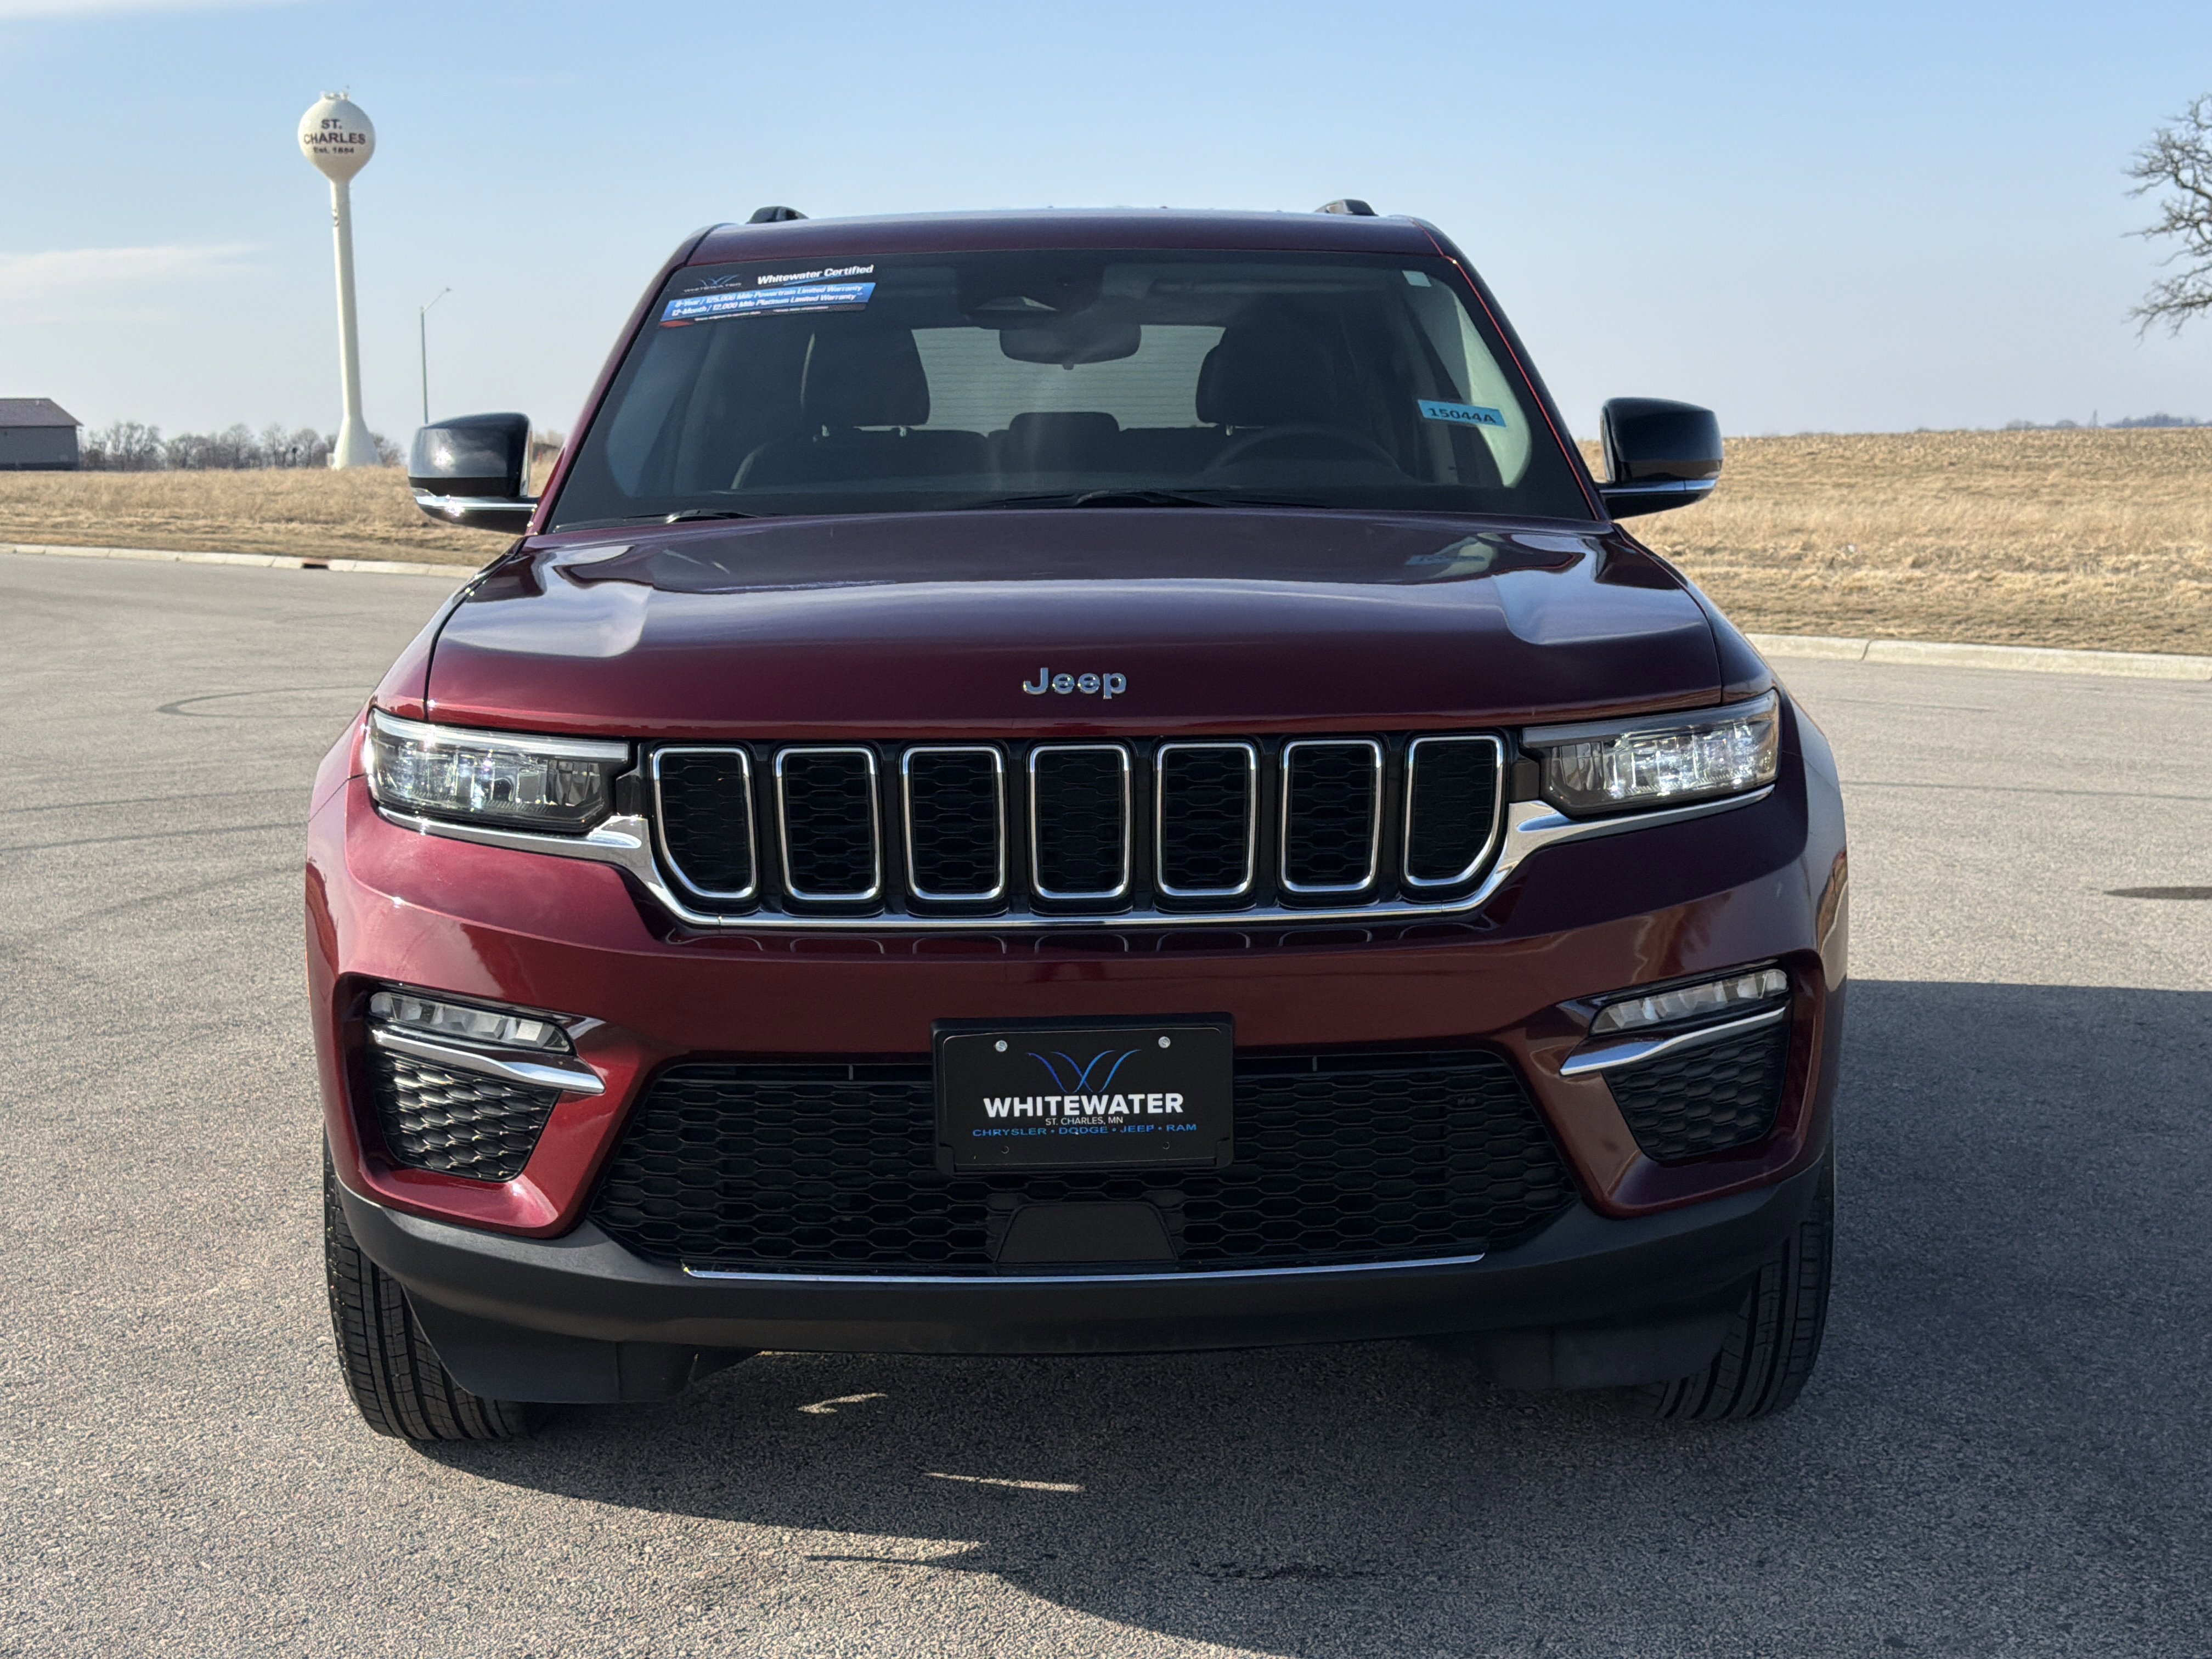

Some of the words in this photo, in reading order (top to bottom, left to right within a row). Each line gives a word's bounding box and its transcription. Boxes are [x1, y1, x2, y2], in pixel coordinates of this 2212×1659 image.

[321, 119, 342, 129] ST.
[303, 132, 366, 145] CHARLES
[757, 270, 822, 285] Whitewater
[823, 264, 874, 276] Certified
[754, 289, 795, 298] Powertrain
[797, 285, 826, 294] Limited
[827, 285, 863, 293] Warranty
[755, 297, 789, 306] Platinum
[790, 295, 819, 303] Limited
[1428, 408, 1496, 423] 15044A
[1023, 668, 1126, 699] Jeep
[984, 1093, 1183, 1117] WHITEWATER
[1060, 1116, 1106, 1125] CHARLES,
[1108, 1116, 1124, 1124] MN
[973, 1127, 1047, 1136] CHRYSLER
[1059, 1126, 1108, 1135] DODGE
[1120, 1124, 1154, 1133] JEEP
[1166, 1124, 1197, 1132] RAM
